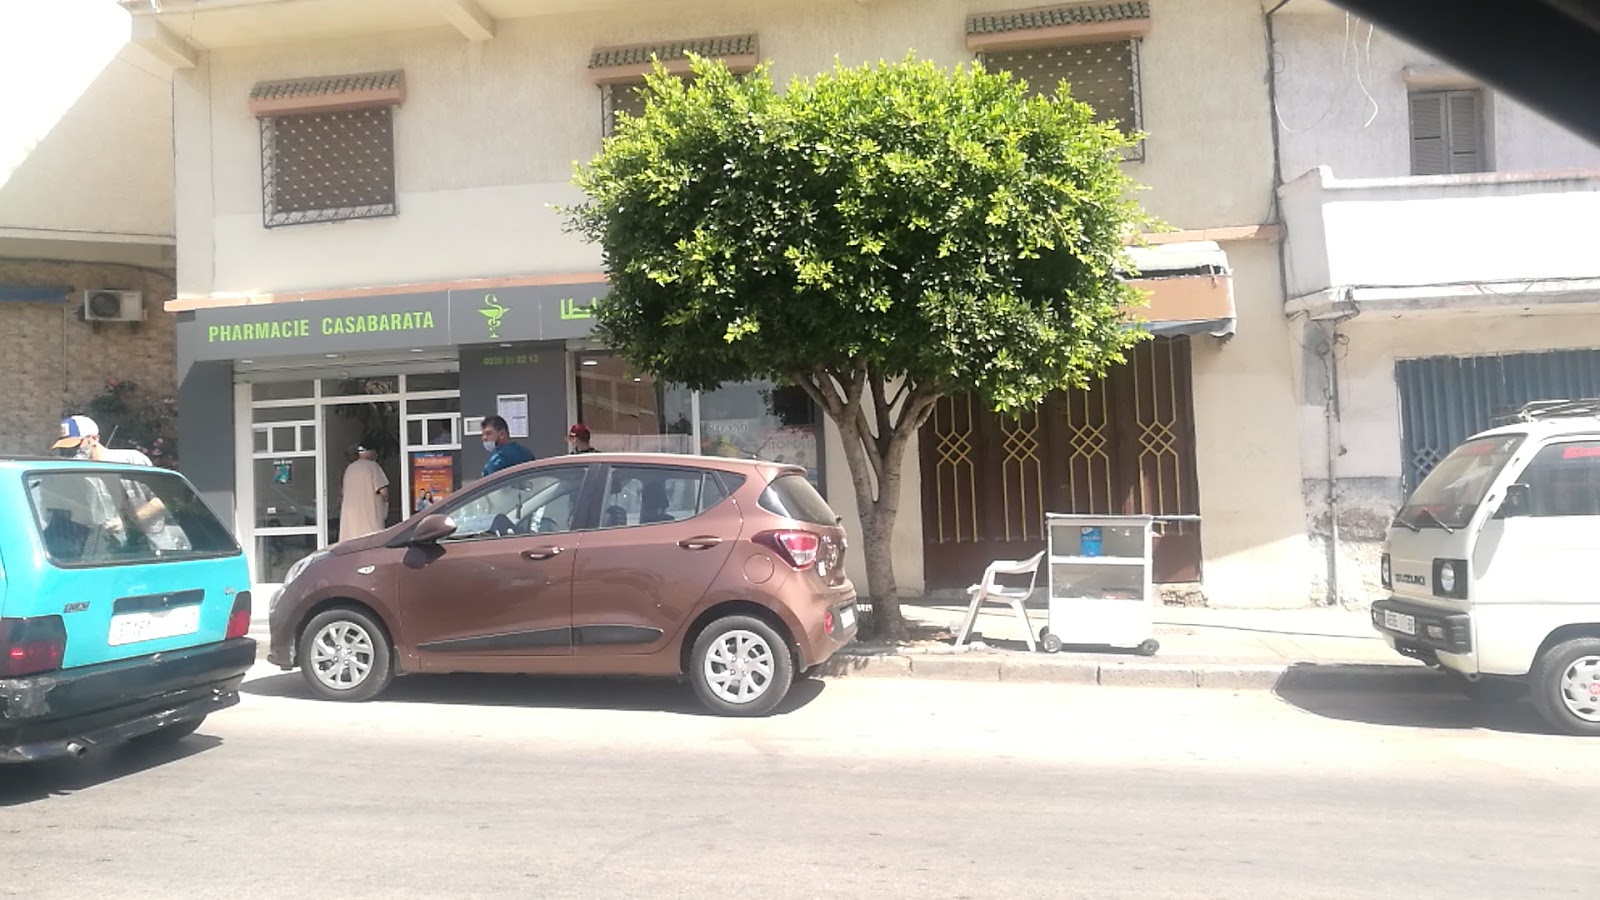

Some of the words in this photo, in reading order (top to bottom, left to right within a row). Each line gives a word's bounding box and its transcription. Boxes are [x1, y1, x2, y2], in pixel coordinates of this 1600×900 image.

[208, 319, 310, 342] PHARMACIE
[321, 311, 434, 335] CASABARATA
[1395, 573, 1426, 586] SUZUKI
